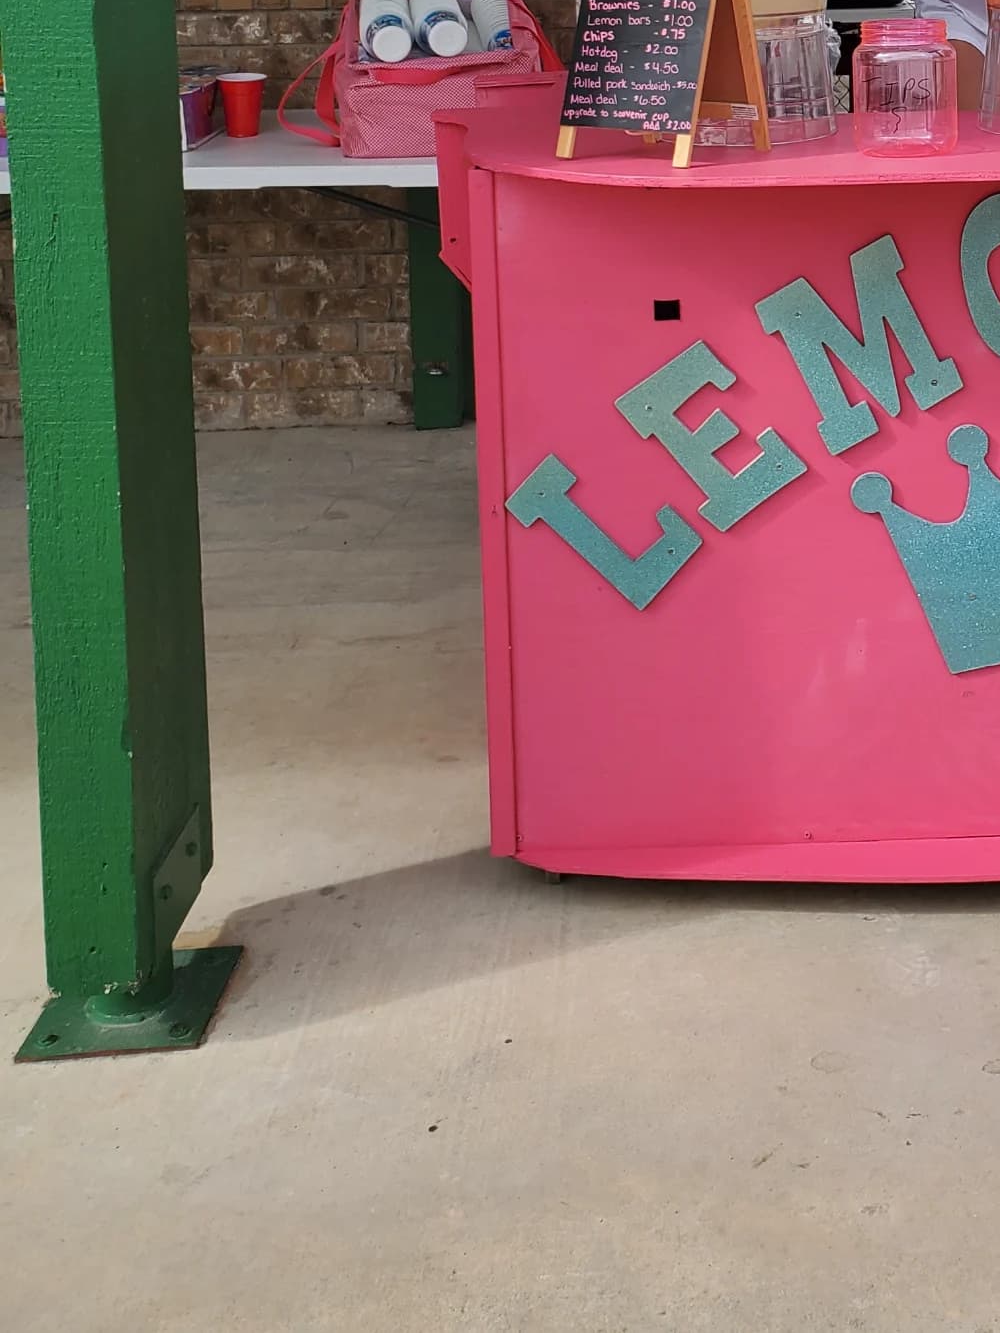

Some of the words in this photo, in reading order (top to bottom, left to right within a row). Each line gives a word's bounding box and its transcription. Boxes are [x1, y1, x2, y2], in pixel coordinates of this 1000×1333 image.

[589, 0, 640, 10] Brownies
[664, 0, 696, 11] $1.00
[588, 15, 622, 26] Lemon
[629, 15, 651, 25] bars
[664, 14, 693, 26] $1.00
[582, 46, 617, 63] Hotdog
[645, 44, 678, 55] $2.00
[575, 62, 598, 72] Meal
[604, 63, 623, 73] deal
[644, 62, 679, 74] $4.50
[574, 76, 600, 88] Pulled
[606, 79, 627, 91] pork
[570, 94, 593, 104] Meal
[596, 94, 617, 104] deal
[634, 95, 666, 105] $6.50
[861, 76, 931, 113] TIPS
[613, 110, 647, 119] souvenir
[652, 113, 669, 122] cup
[666, 121, 691, 130] $2.00
